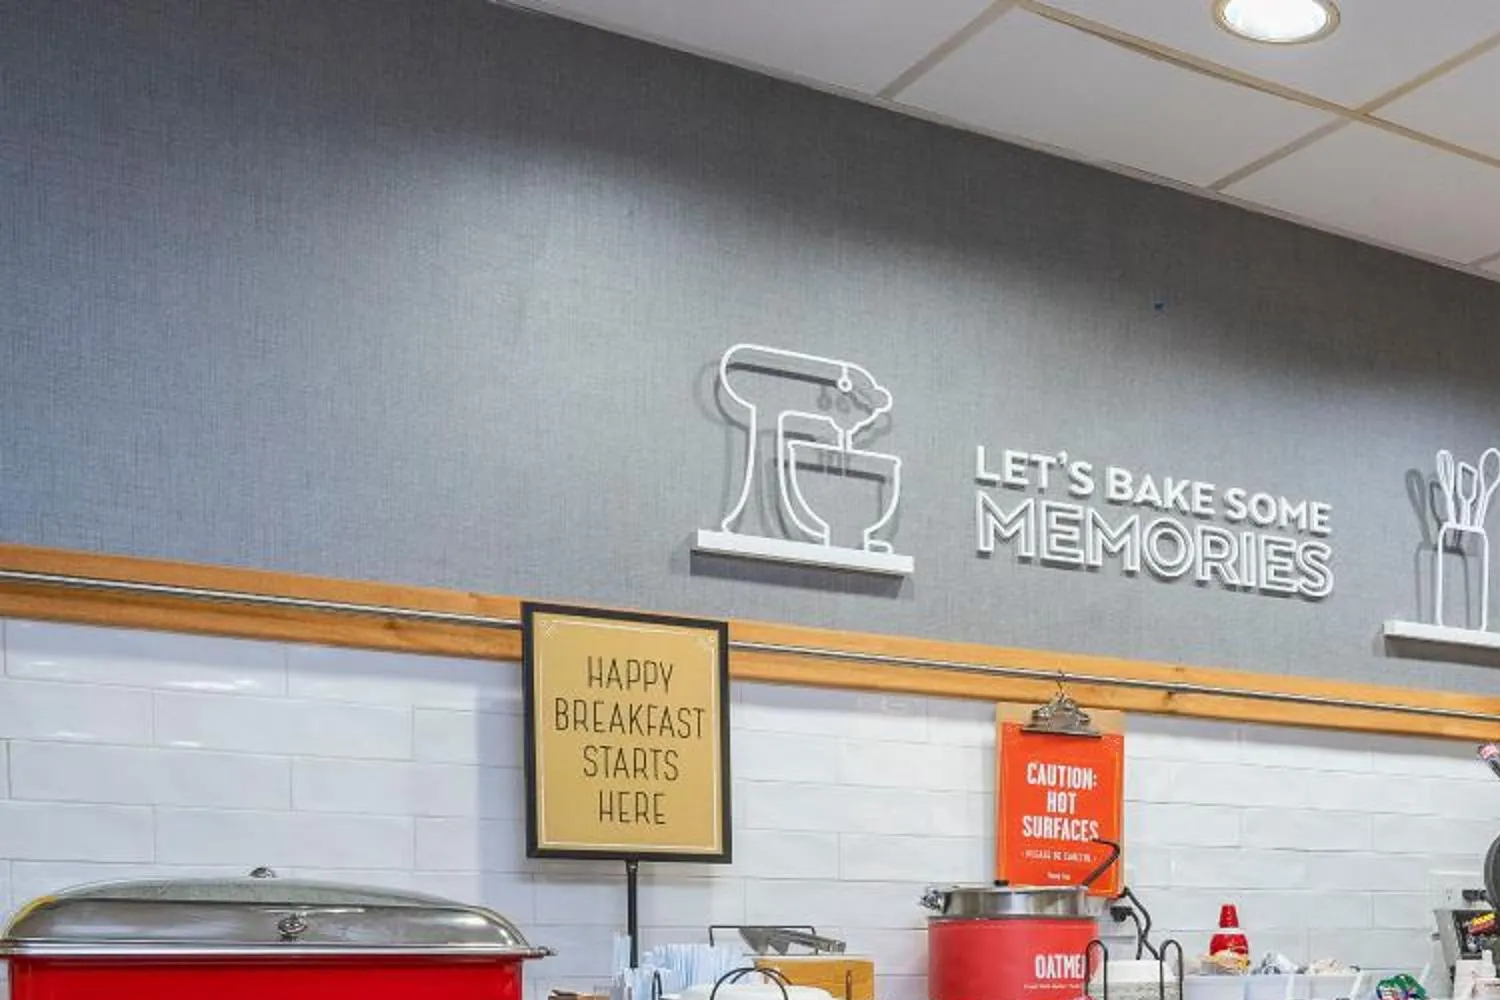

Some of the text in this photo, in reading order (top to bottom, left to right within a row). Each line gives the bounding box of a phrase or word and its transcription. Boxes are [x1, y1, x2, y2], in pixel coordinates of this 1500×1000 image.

[975, 445, 1333, 535] LET'S BAKE SOME
[976, 490, 1334, 598] MEMORIES
[587, 655, 674, 694] HAPPY
[554, 697, 706, 739] BREAKFAST
[583, 745, 680, 781] STARTS
[1026, 762, 1098, 791] CAUTION:
[599, 789, 667, 825] HERE
[1046, 791, 1077, 814] HOT
[1022, 815, 1099, 842] SURFACES
[1034, 953, 1086, 979] OATME
